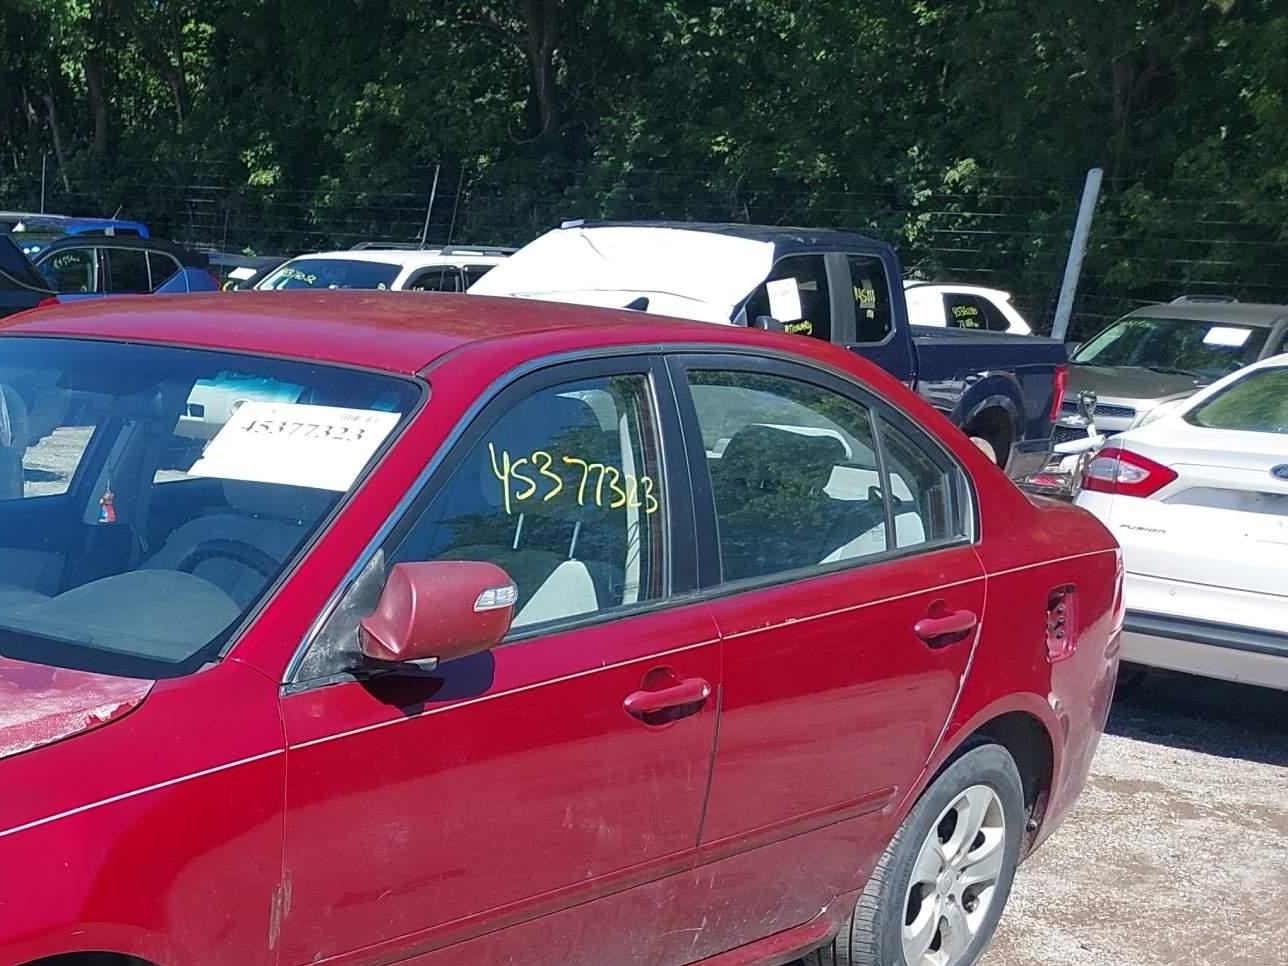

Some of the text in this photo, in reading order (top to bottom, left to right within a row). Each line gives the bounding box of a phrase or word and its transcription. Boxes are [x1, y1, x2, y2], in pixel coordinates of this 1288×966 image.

[241, 419, 365, 442] 45377323
[487, 441, 659, 516] 45377323
[1119, 523, 1167, 535] FUSION
